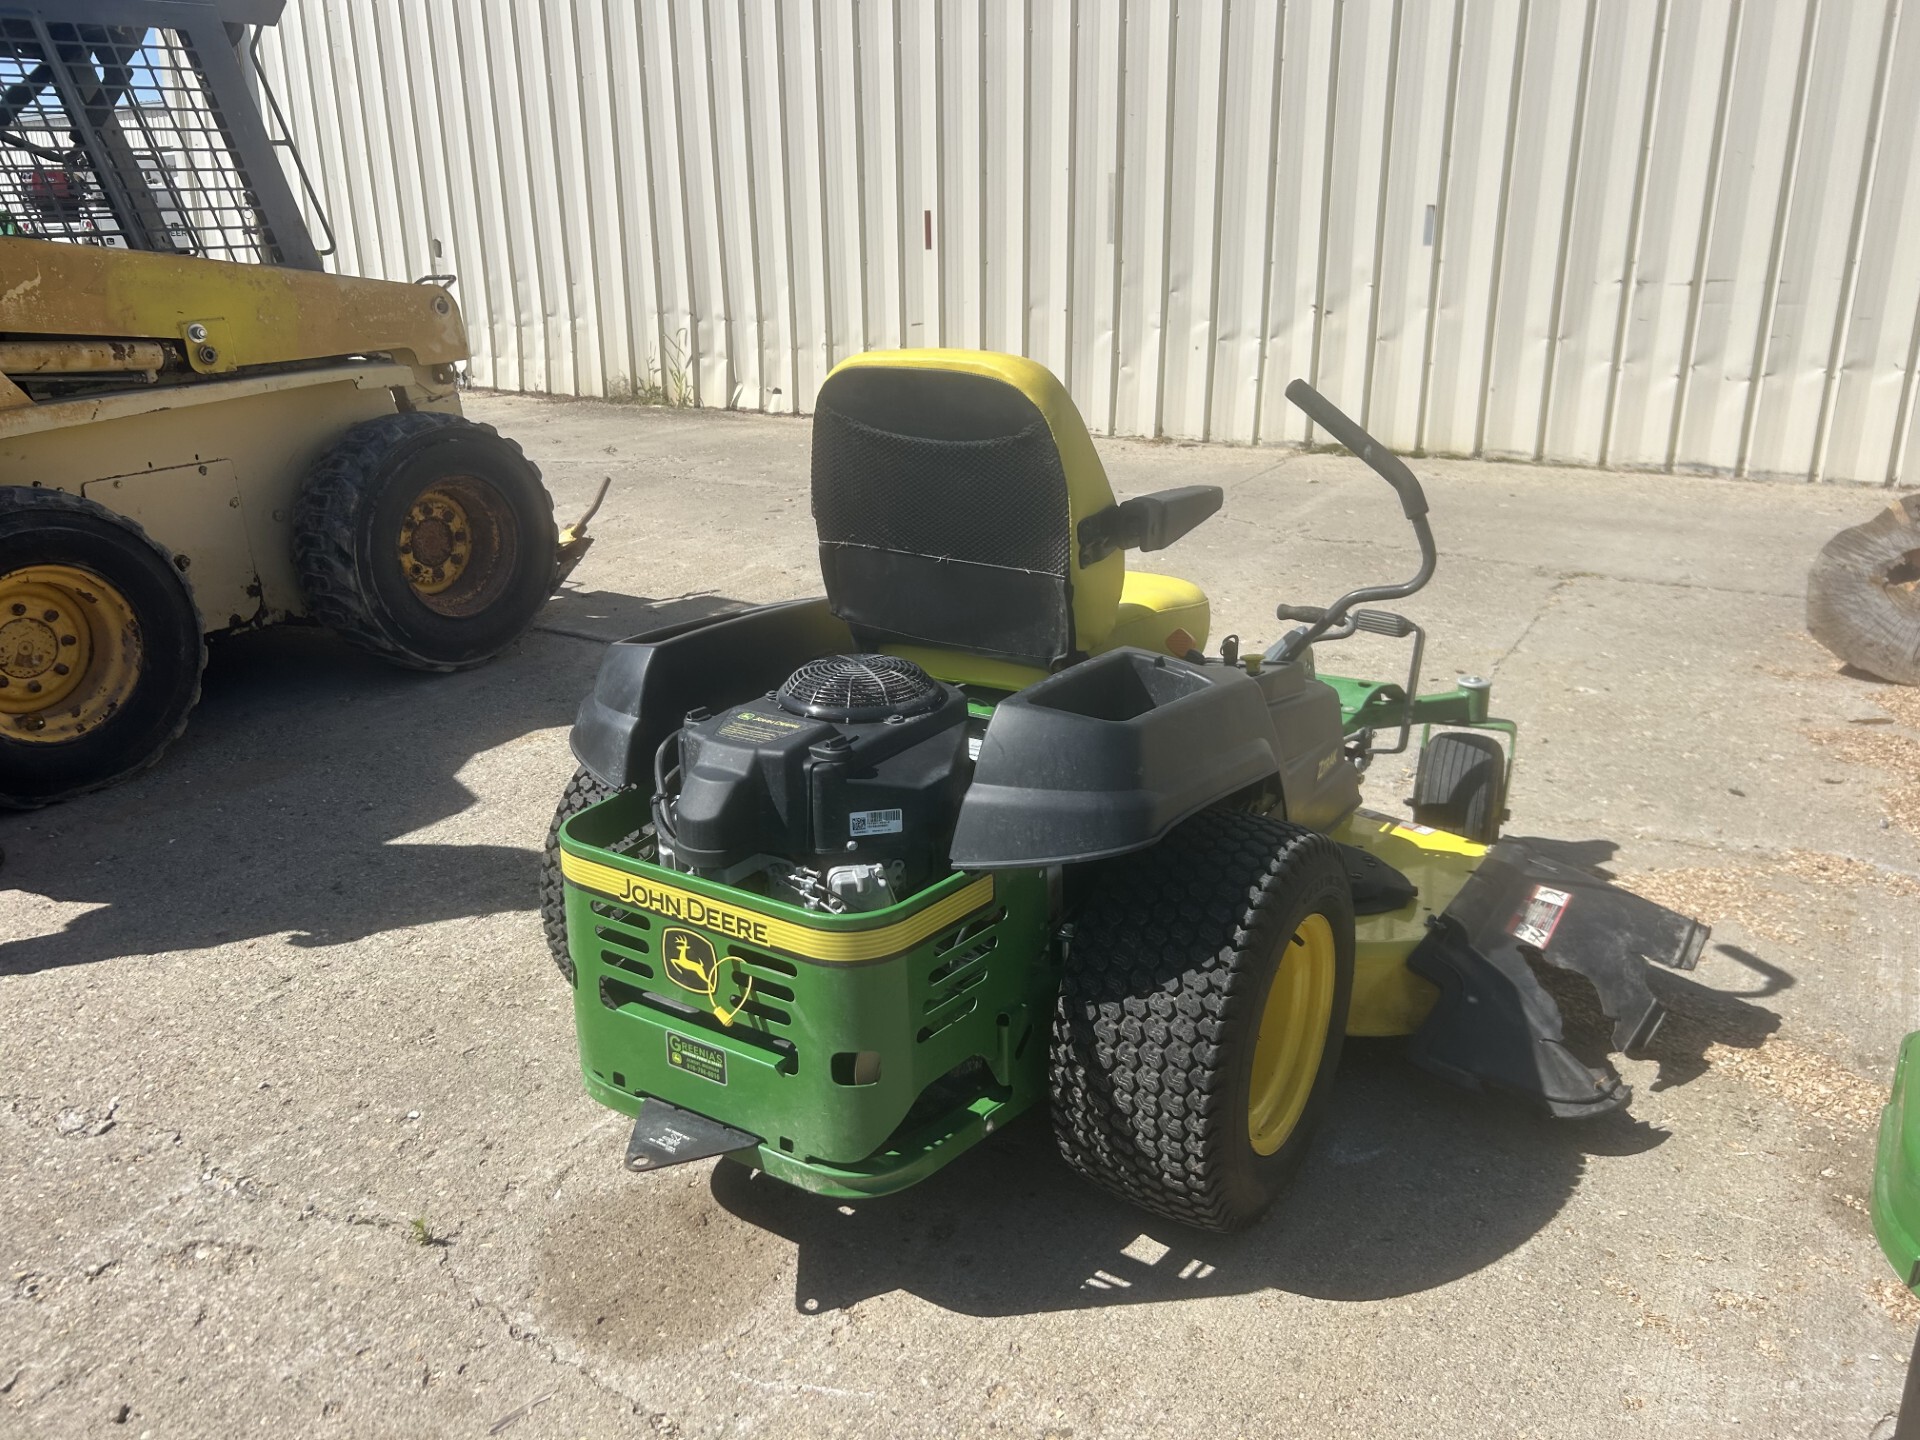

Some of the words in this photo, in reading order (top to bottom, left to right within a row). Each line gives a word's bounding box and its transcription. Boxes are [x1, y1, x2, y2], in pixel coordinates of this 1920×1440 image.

[619, 878, 682, 918] JOHN
[687, 897, 769, 945] DEERE
[669, 1034, 723, 1064] GREENIA'S
